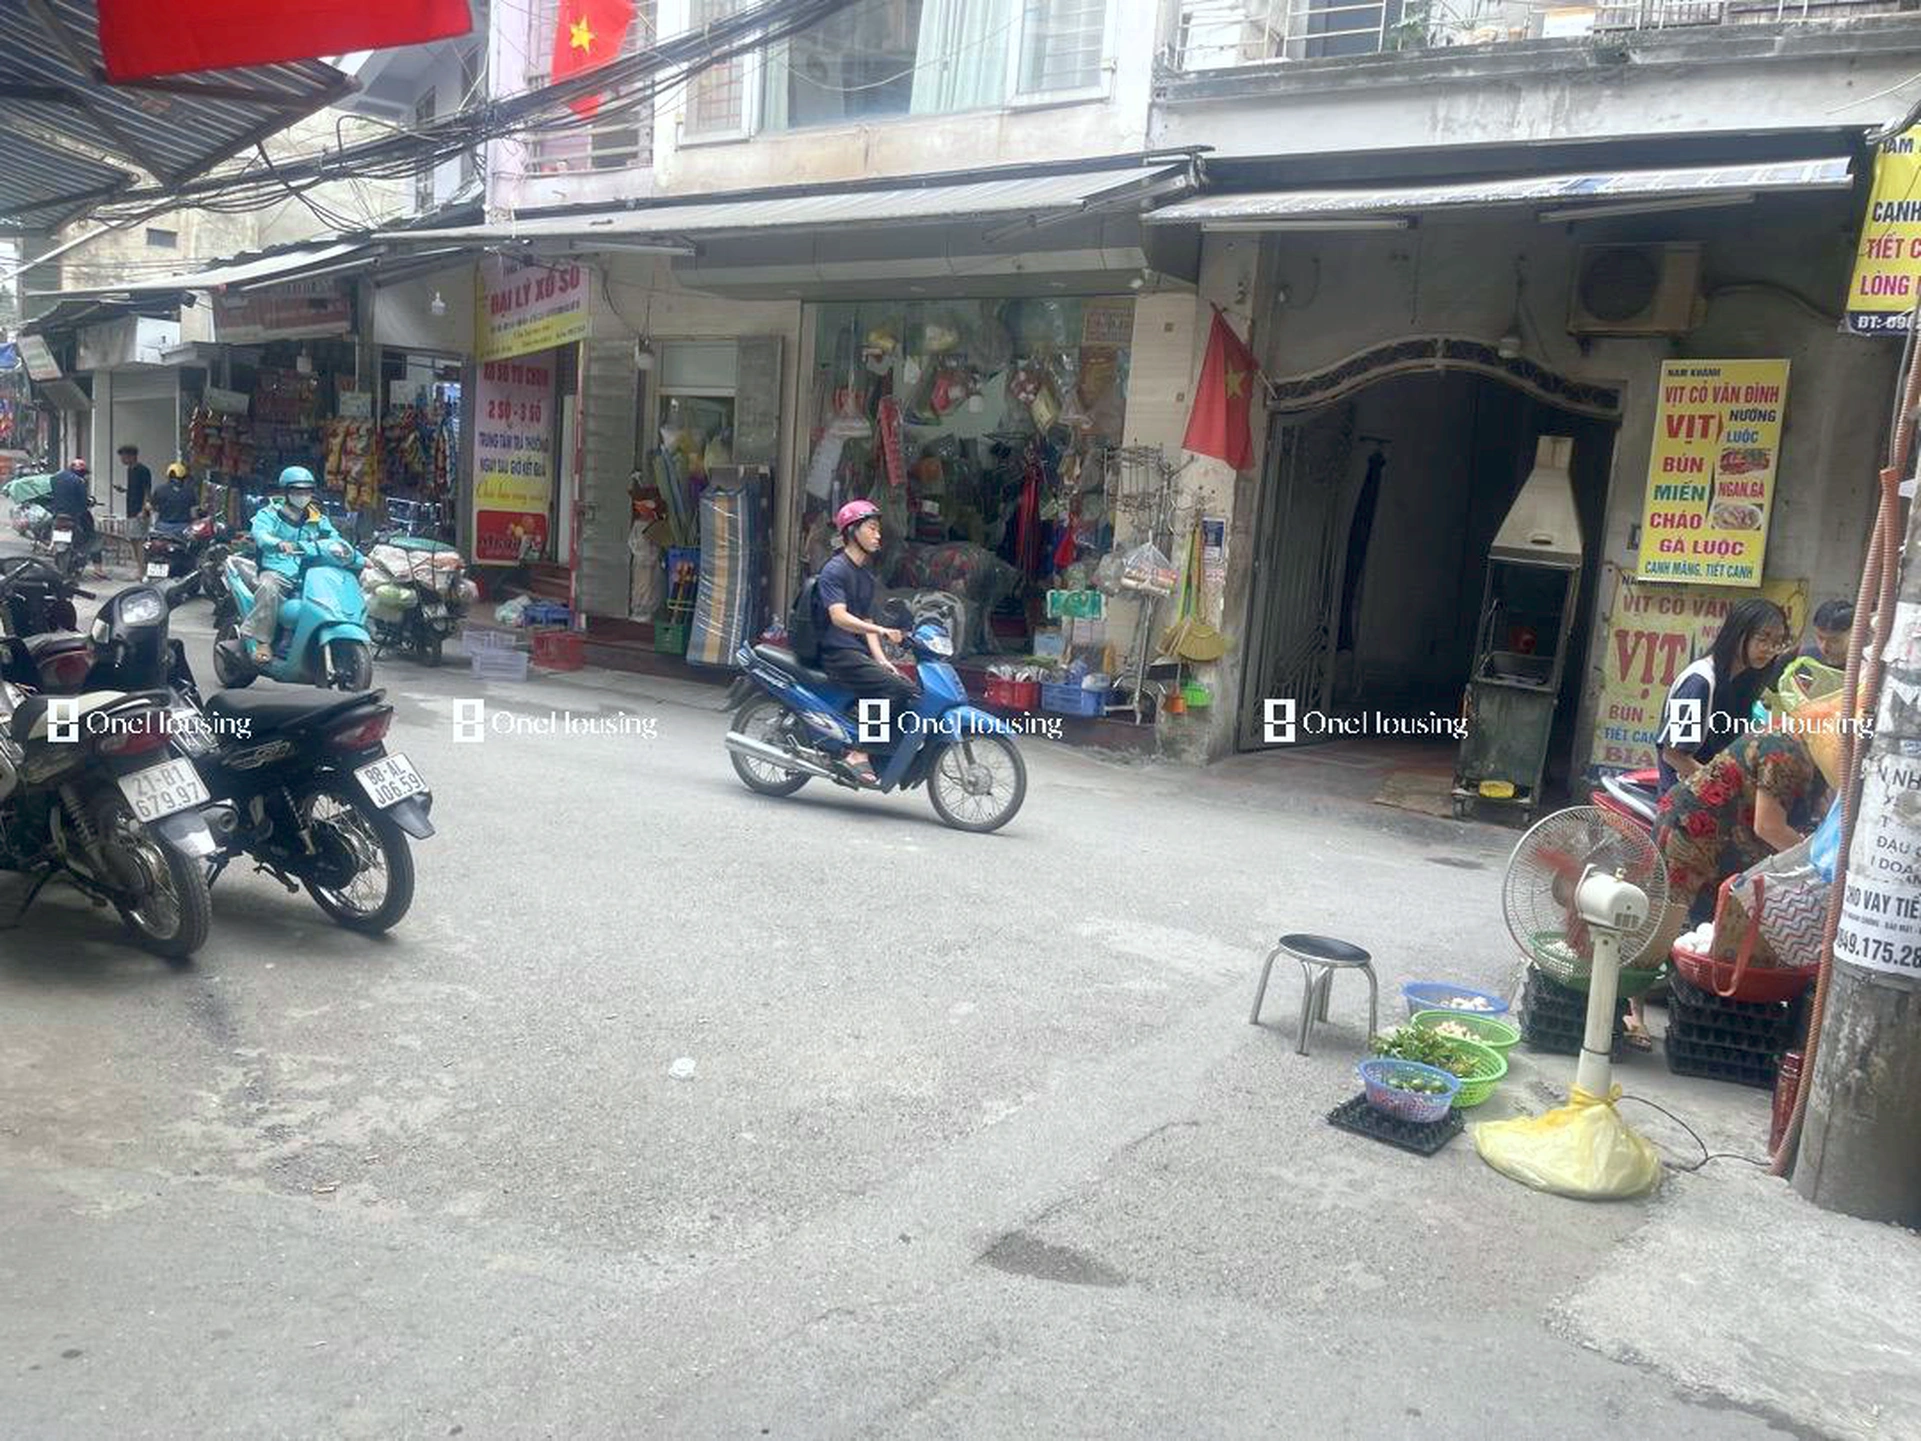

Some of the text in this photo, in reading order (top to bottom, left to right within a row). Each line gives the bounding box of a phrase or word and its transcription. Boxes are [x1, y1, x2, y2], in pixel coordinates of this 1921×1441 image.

[1860, 270, 1910, 295] LÒNG
[1665, 386, 1686, 407] VỊT
[1689, 380, 1708, 404] CỎ
[1744, 382, 1779, 404] ĐÌNH
[1666, 414, 1716, 445] VỊT
[1662, 453, 1704, 473] BÚN
[1653, 480, 1706, 502] MIẾN
[1650, 509, 1703, 529] CHÁO
[1660, 536, 1745, 559] GÀ LUỘC
[1615, 628, 1687, 699] VỊT
[1605, 747, 1656, 766] BIA
[136, 782, 199, 817] 679.97
[1864, 889, 1891, 914] VAY
